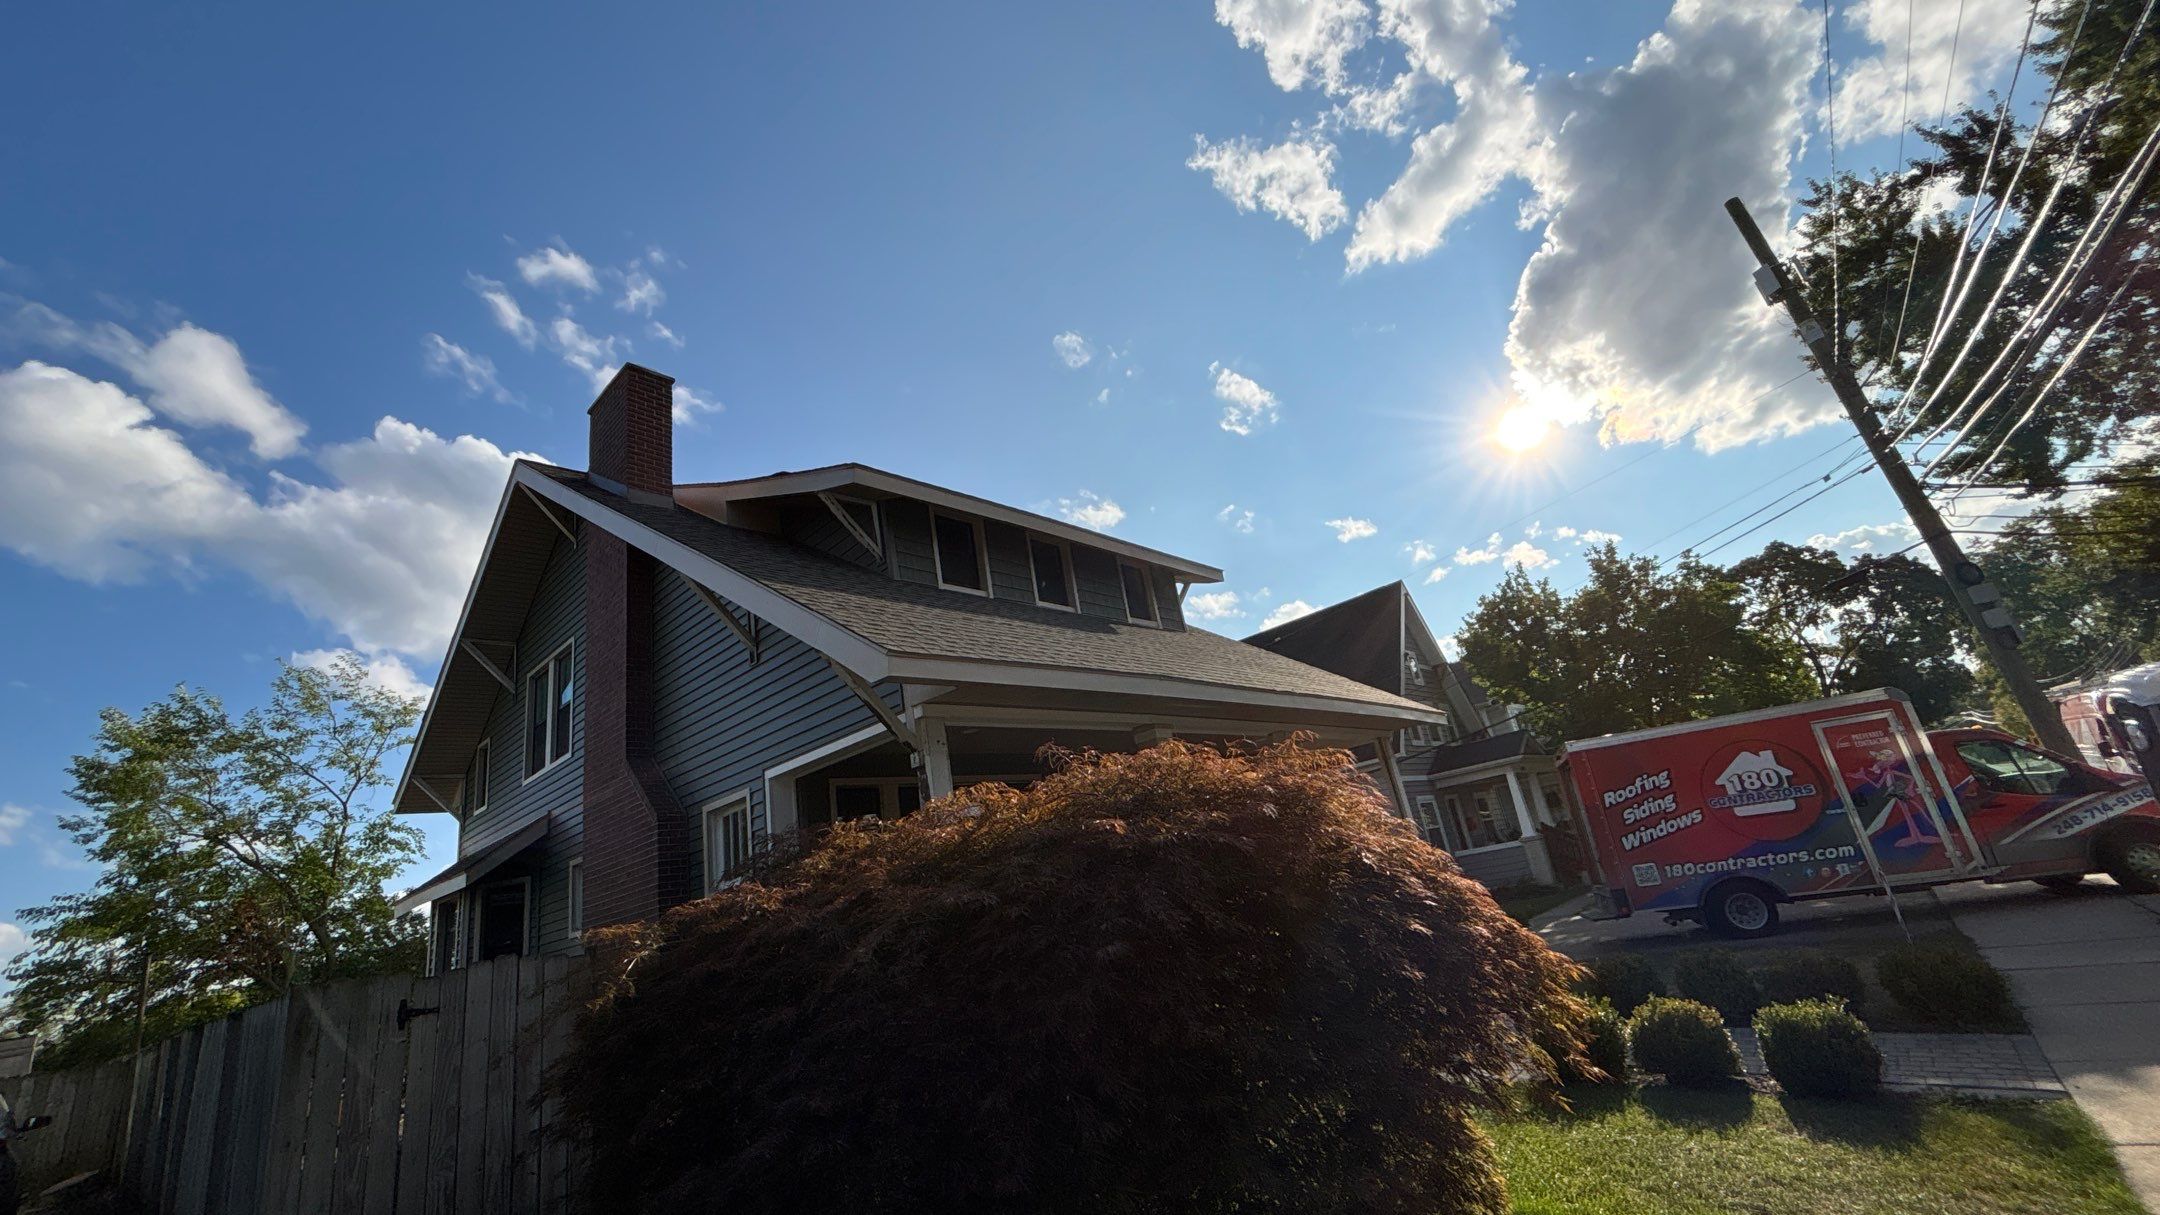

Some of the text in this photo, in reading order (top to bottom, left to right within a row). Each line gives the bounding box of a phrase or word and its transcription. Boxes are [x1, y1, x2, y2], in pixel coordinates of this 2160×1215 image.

[1603, 770, 1671, 808] Roofing
[1708, 783, 1817, 808] CONTRACTORS
[1727, 767, 1780, 792] 180
[1622, 794, 1677, 825] Siding
[1621, 809, 1703, 851] Windows
[1664, 845, 1856, 878] 180contractors.com
